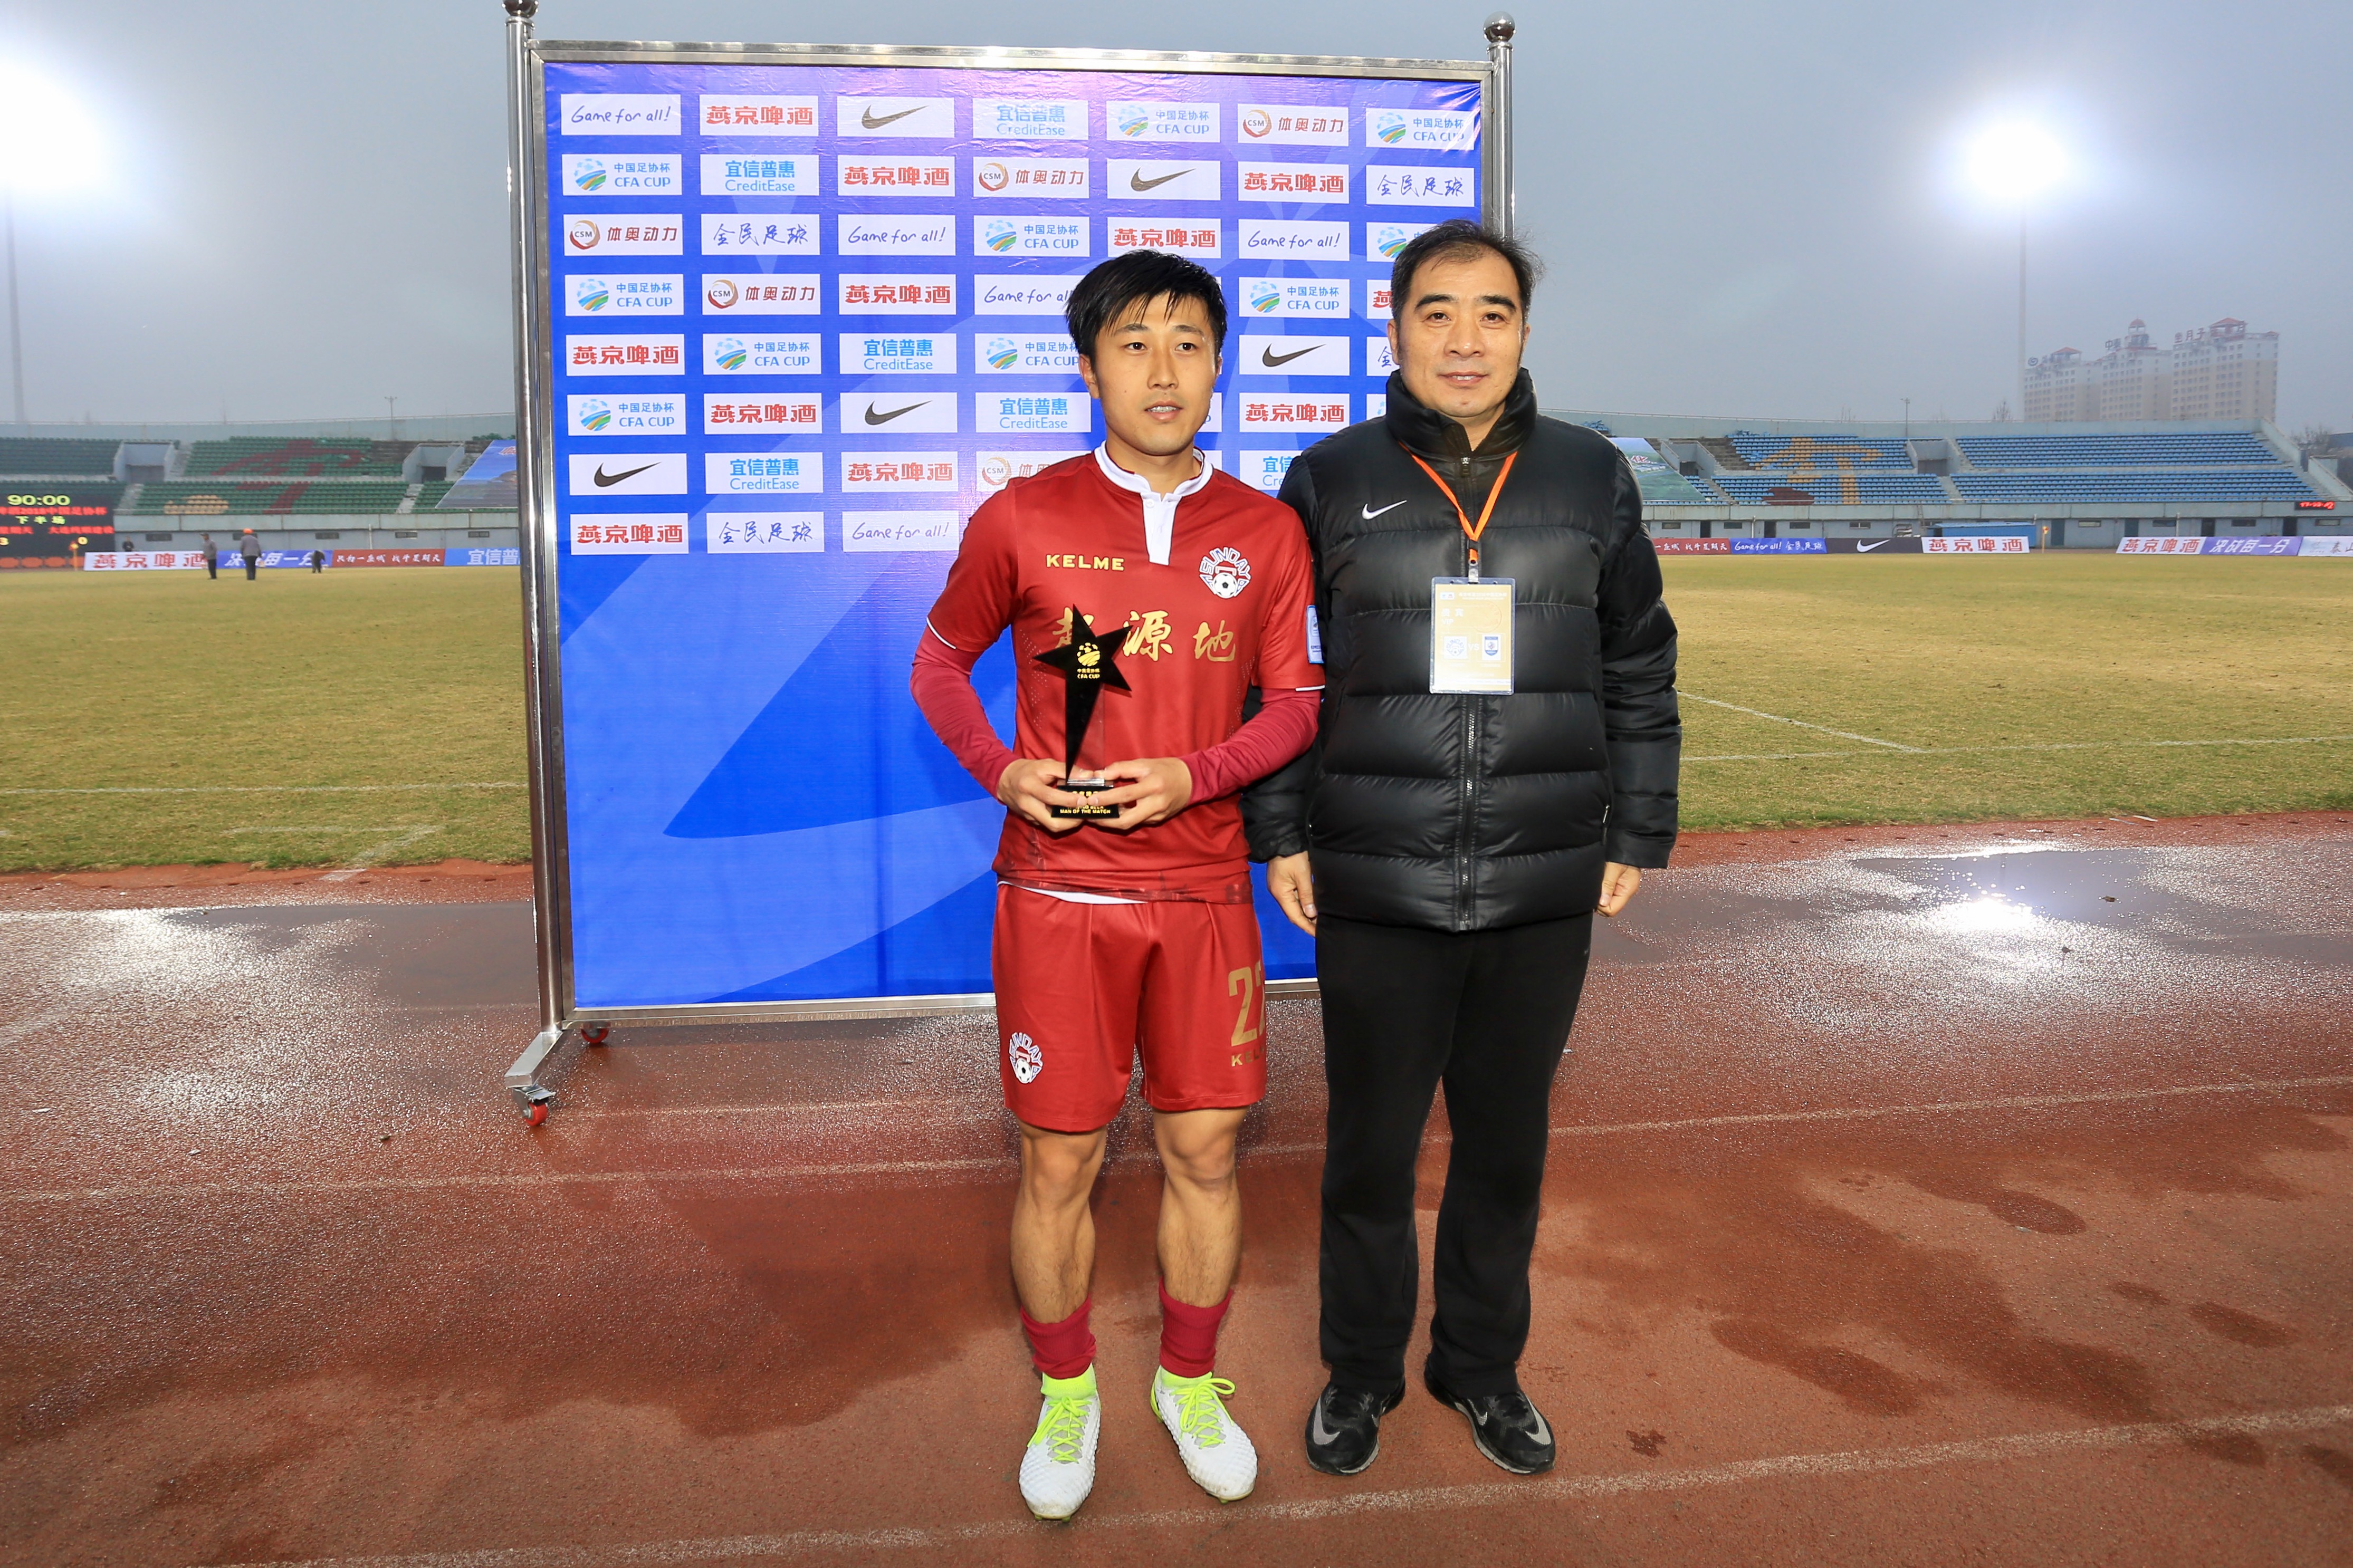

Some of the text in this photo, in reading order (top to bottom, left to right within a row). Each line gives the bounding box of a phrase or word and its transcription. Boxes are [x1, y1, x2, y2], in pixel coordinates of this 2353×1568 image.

[571, 105, 671, 123] Game for all!
[706, 106, 812, 125] 燕京啤酒
[1156, 110, 1209, 121] 中国足协杯
[1156, 124, 1209, 134] CFA CUP
[1278, 118, 1343, 132] 体奥动力
[1413, 118, 1463, 128] 中国足协杯
[1413, 132, 1436, 141] CFA
[614, 163, 670, 172] 中国足协杯
[725, 160, 795, 178] 宜信普惠
[615, 177, 671, 187] CFA CUP
[844, 167, 949, 186] 燕京啤酒
[1016, 170, 1084, 185] 体奥动力
[1245, 172, 1343, 193] 燕京啤酒
[725, 179, 795, 191] CreditEase
[1378, 175, 1463, 197] 全民足球
[575, 227, 677, 241] CSM 体奥动力
[714, 223, 808, 246] 全民足球
[848, 226, 945, 244] Game for all!
[1025, 225, 1078, 235] 中国足协杯
[1113, 228, 1215, 247] 燕京啤酒
[1025, 239, 1078, 248] CFA CUP
[1248, 230, 1340, 249] Game for all!
[617, 283, 672, 293] 中国足协杯
[745, 286, 815, 301] 体奥动力
[845, 285, 950, 303] 燕京啤酒
[984, 285, 1023, 303] Game
[1027, 289, 1051, 304] for
[1287, 286, 1338, 296] 中国足协杯
[617, 297, 672, 307] CFA CUP
[1288, 301, 1339, 310] CFA CUP
[573, 345, 678, 364] 燕京啤酒
[754, 342, 809, 352] 中国足协杯
[864, 339, 932, 356] 宜信普惠
[755, 357, 810, 366] CFA CUP
[864, 358, 933, 370] CreditEase
[1026, 356, 1079, 365] CFA CUP
[619, 402, 674, 412] 中国足协杯
[711, 404, 816, 423] 燕京啤酒
[1000, 398, 1067, 415] 宜信普惠
[1246, 403, 1344, 422] 燕京啤酒
[619, 417, 674, 427] CFA CUP
[1000, 417, 1067, 428] CreditEase
[730, 458, 799, 476] 宜信普惠
[848, 463, 952, 482] 燕京啤酒
[730, 478, 799, 489] CreditEase
[7, 495, 70, 506] 90:00
[577, 524, 682, 543] 燕京啤酒
[719, 521, 812, 544] 全民足球
[852, 522, 949, 540] Game for all!
[1735, 541, 1754, 551] Game
[1755, 542, 1768, 551] for
[1929, 538, 2023, 552] 燕京啤酒
[2122, 538, 2200, 553] 燕京啤酒
[93, 553, 208, 569] 燕京啤酒
[467, 549, 520, 565] 宜信普
[1046, 554, 1124, 571] KELME
[1199, 547, 1251, 580] SUNDAY
[1231, 1046, 1264, 1067] KEL
